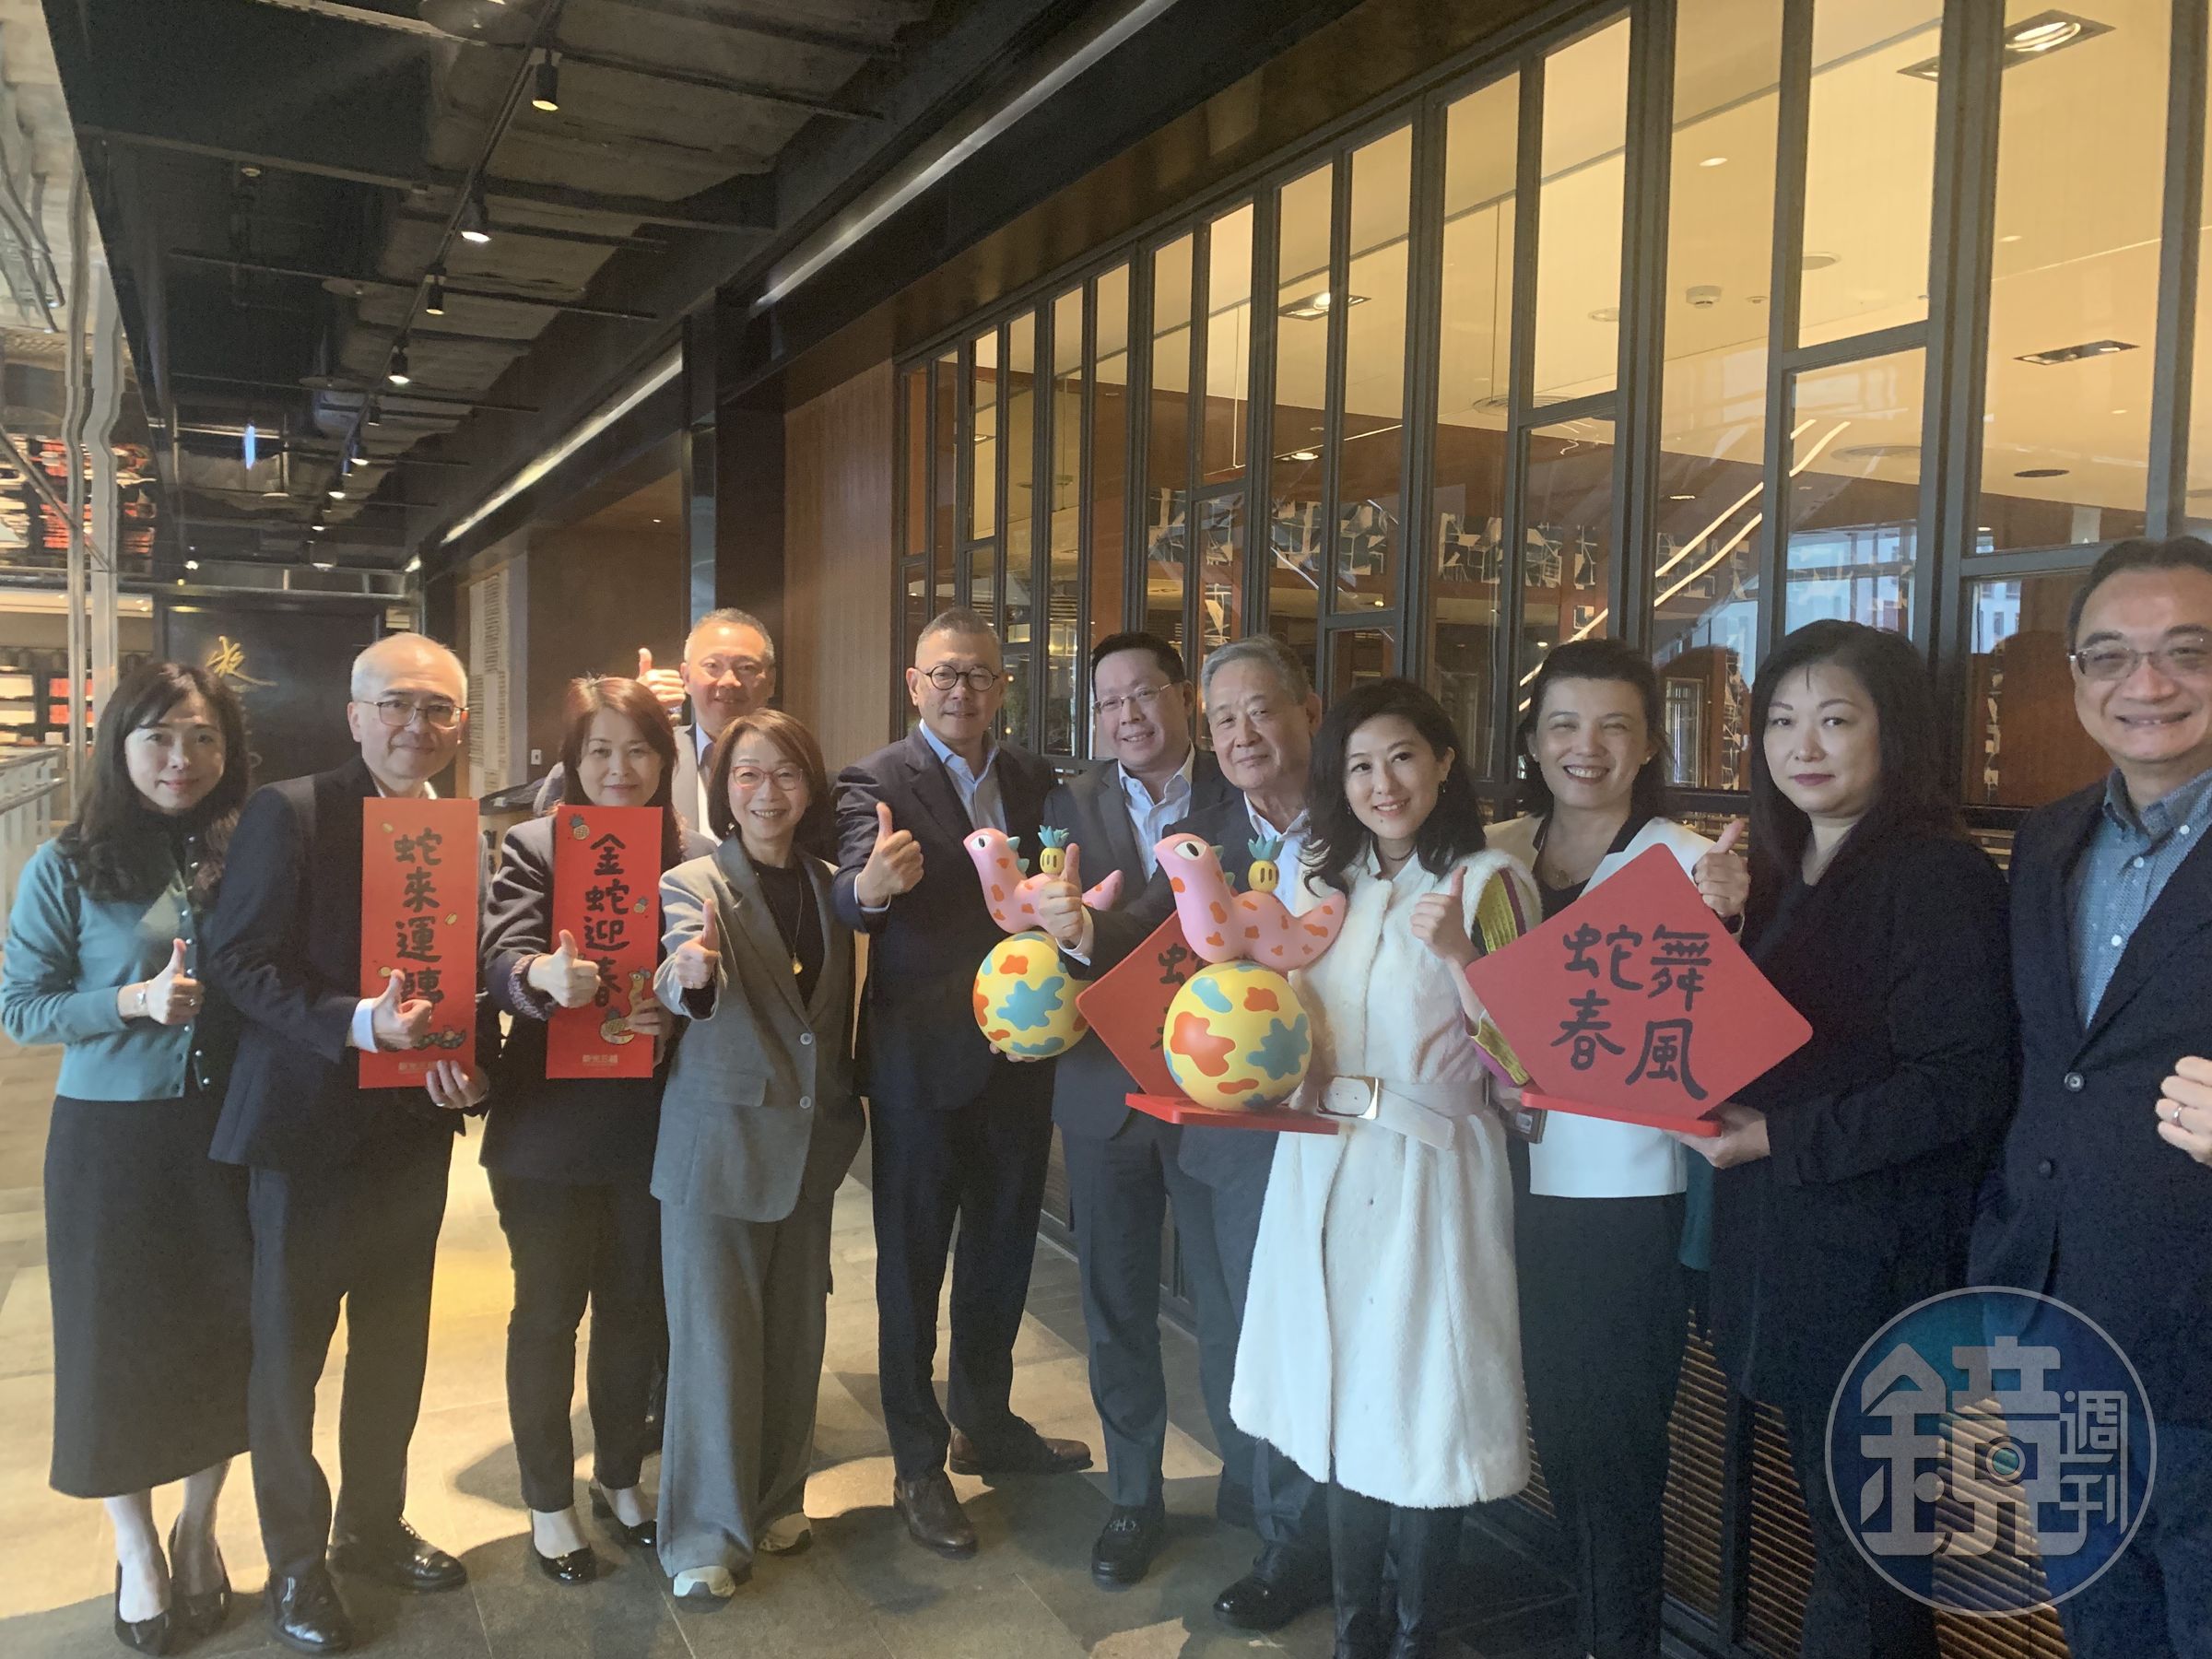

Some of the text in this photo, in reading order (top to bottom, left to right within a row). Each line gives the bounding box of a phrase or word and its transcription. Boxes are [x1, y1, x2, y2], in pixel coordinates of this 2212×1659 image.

[394, 827, 444, 1004] 蛇來運轉
[583, 832, 630, 1007] 金蛇迎春
